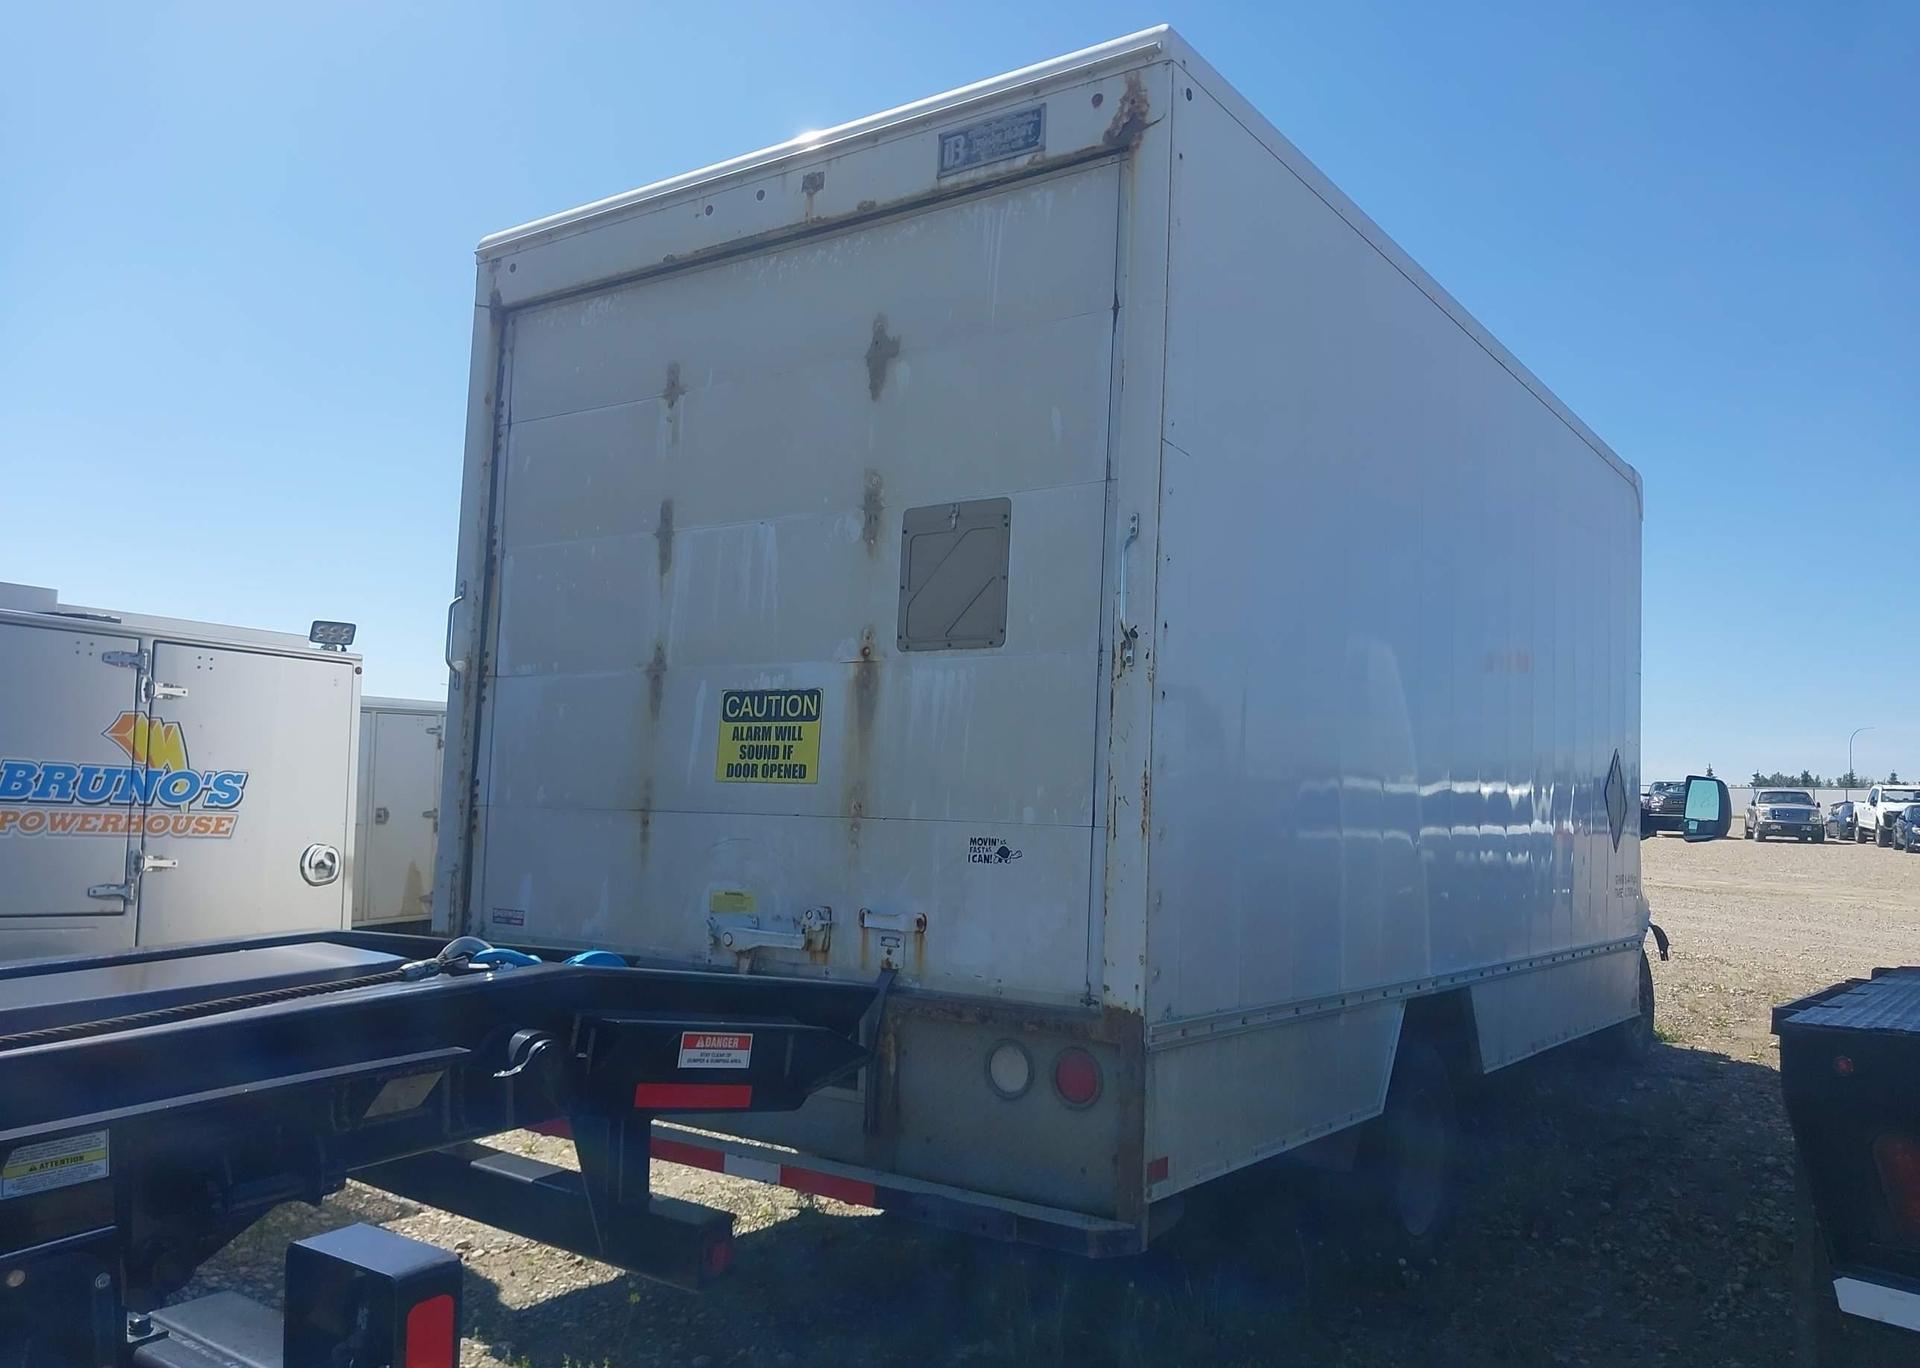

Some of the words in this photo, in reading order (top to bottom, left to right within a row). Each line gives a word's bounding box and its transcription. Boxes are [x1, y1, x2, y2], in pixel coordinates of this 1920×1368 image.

[726, 694, 818, 718] CAUTION
[732, 725, 771, 741] ALARM
[775, 725, 804, 741] WILL
[739, 744, 780, 760] SOUND
[782, 744, 794, 760] IF
[726, 763, 759, 778] DOOR
[761, 763, 807, 779] OPENED
[0, 760, 248, 807] BRUNO'S
[0, 810, 236, 837] POWERHOUSE
[969, 837, 1000, 847] MOVIN'
[972, 854, 993, 864] CAN!
[704, 1036, 739, 1049] DANGER
[40, 1155, 85, 1170] ATTENTION
